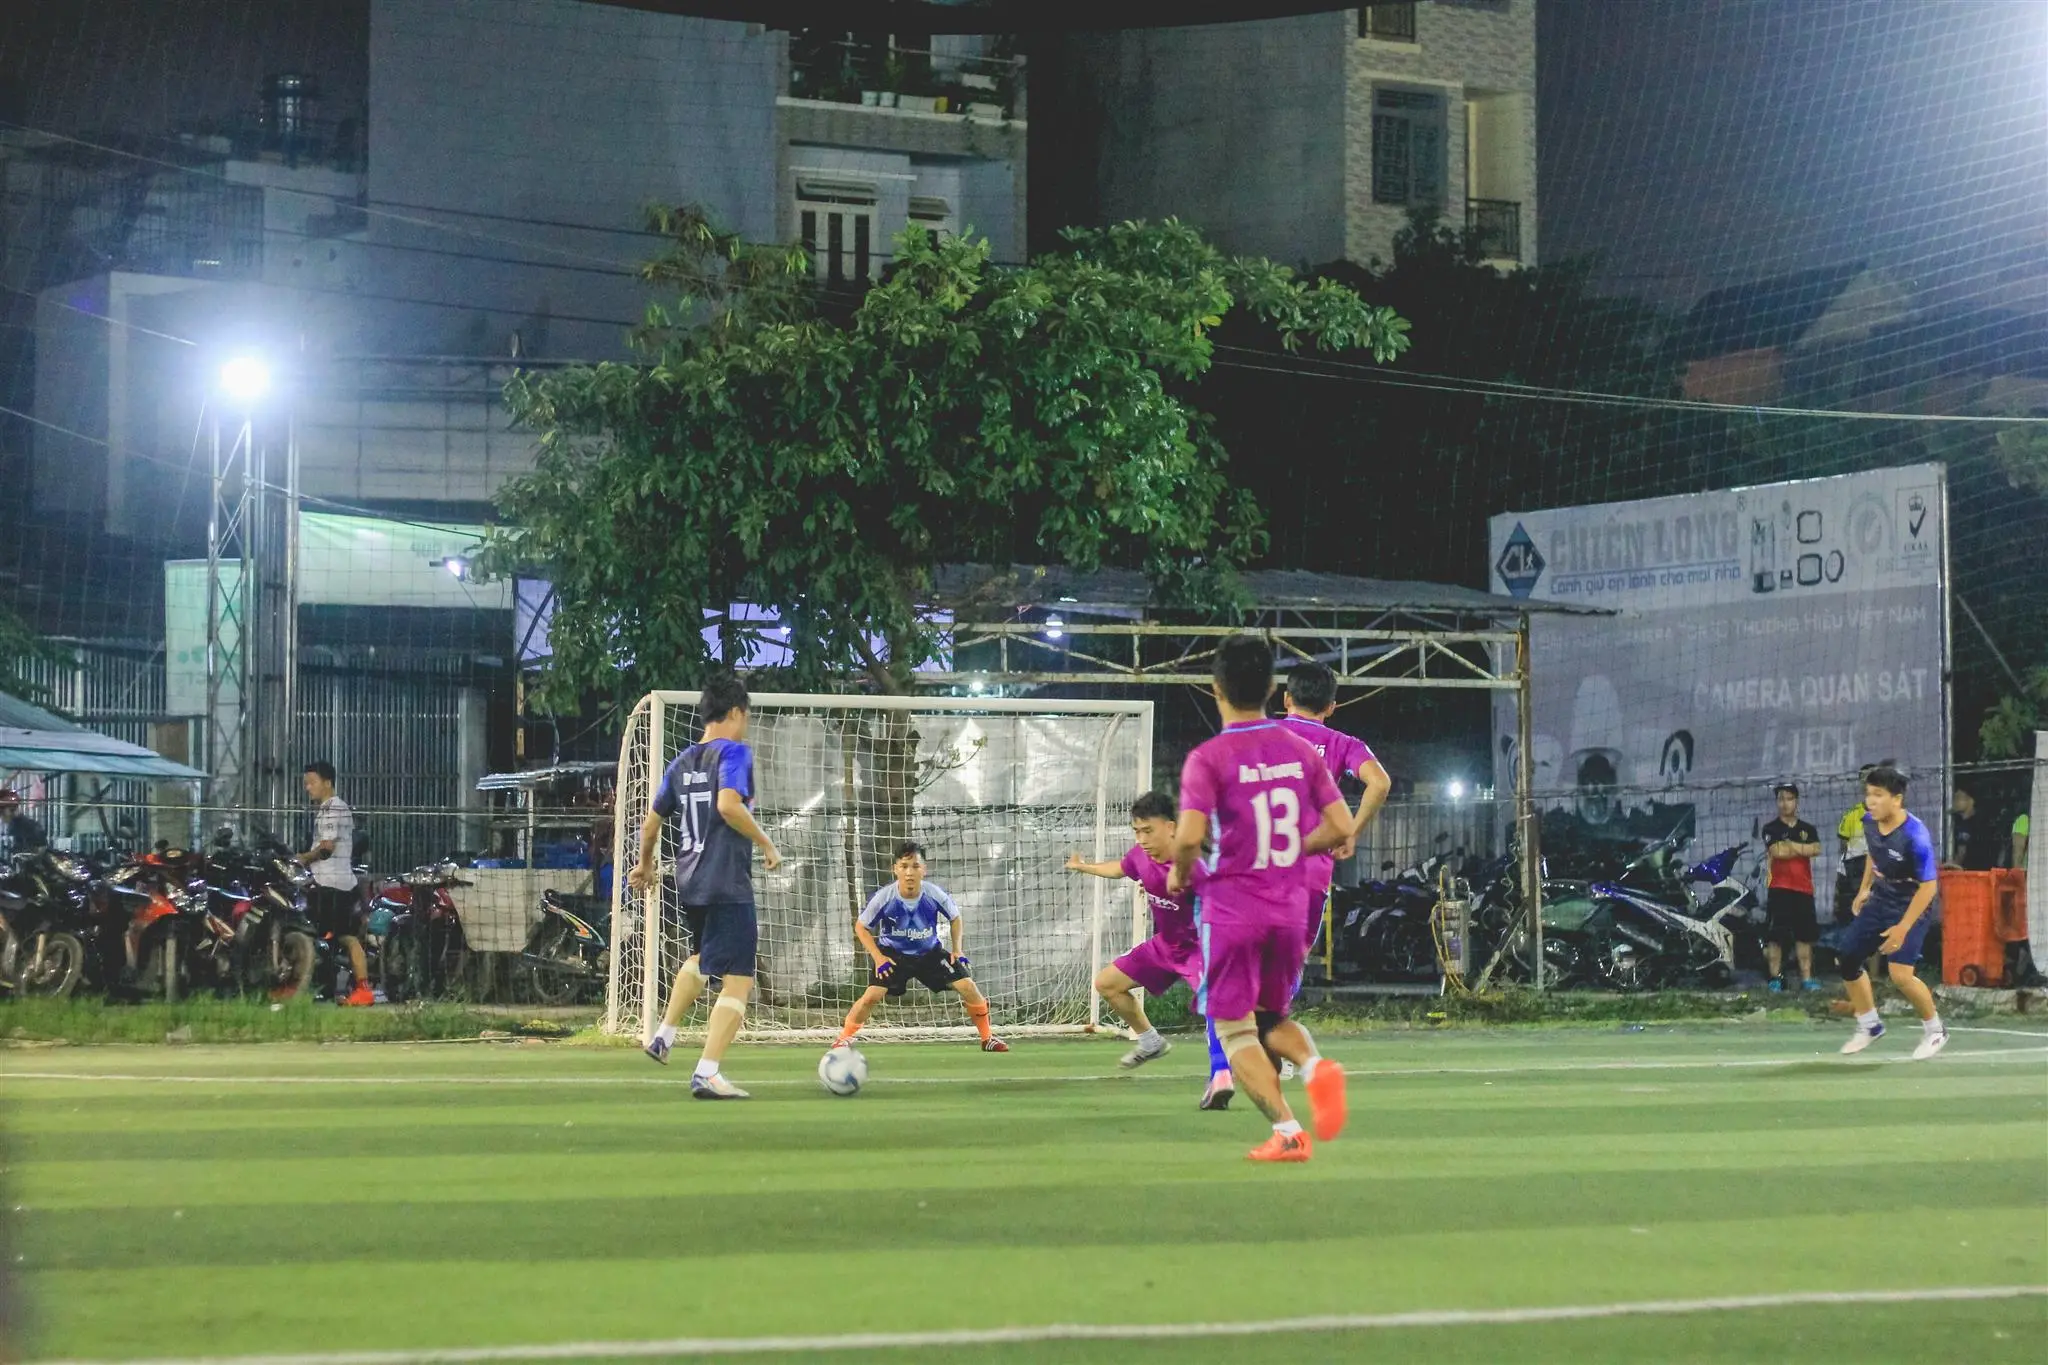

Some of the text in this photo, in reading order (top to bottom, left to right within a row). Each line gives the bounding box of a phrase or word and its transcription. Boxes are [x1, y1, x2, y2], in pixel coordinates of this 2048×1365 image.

[1654, 510, 1739, 563] LONG
[1888, 603, 1927, 625] NAM
[1694, 677, 1793, 711] CAMERA
[1800, 672, 1869, 707] QUAN
[680, 790, 712, 853] 17
[1249, 787, 1301, 870] 13
